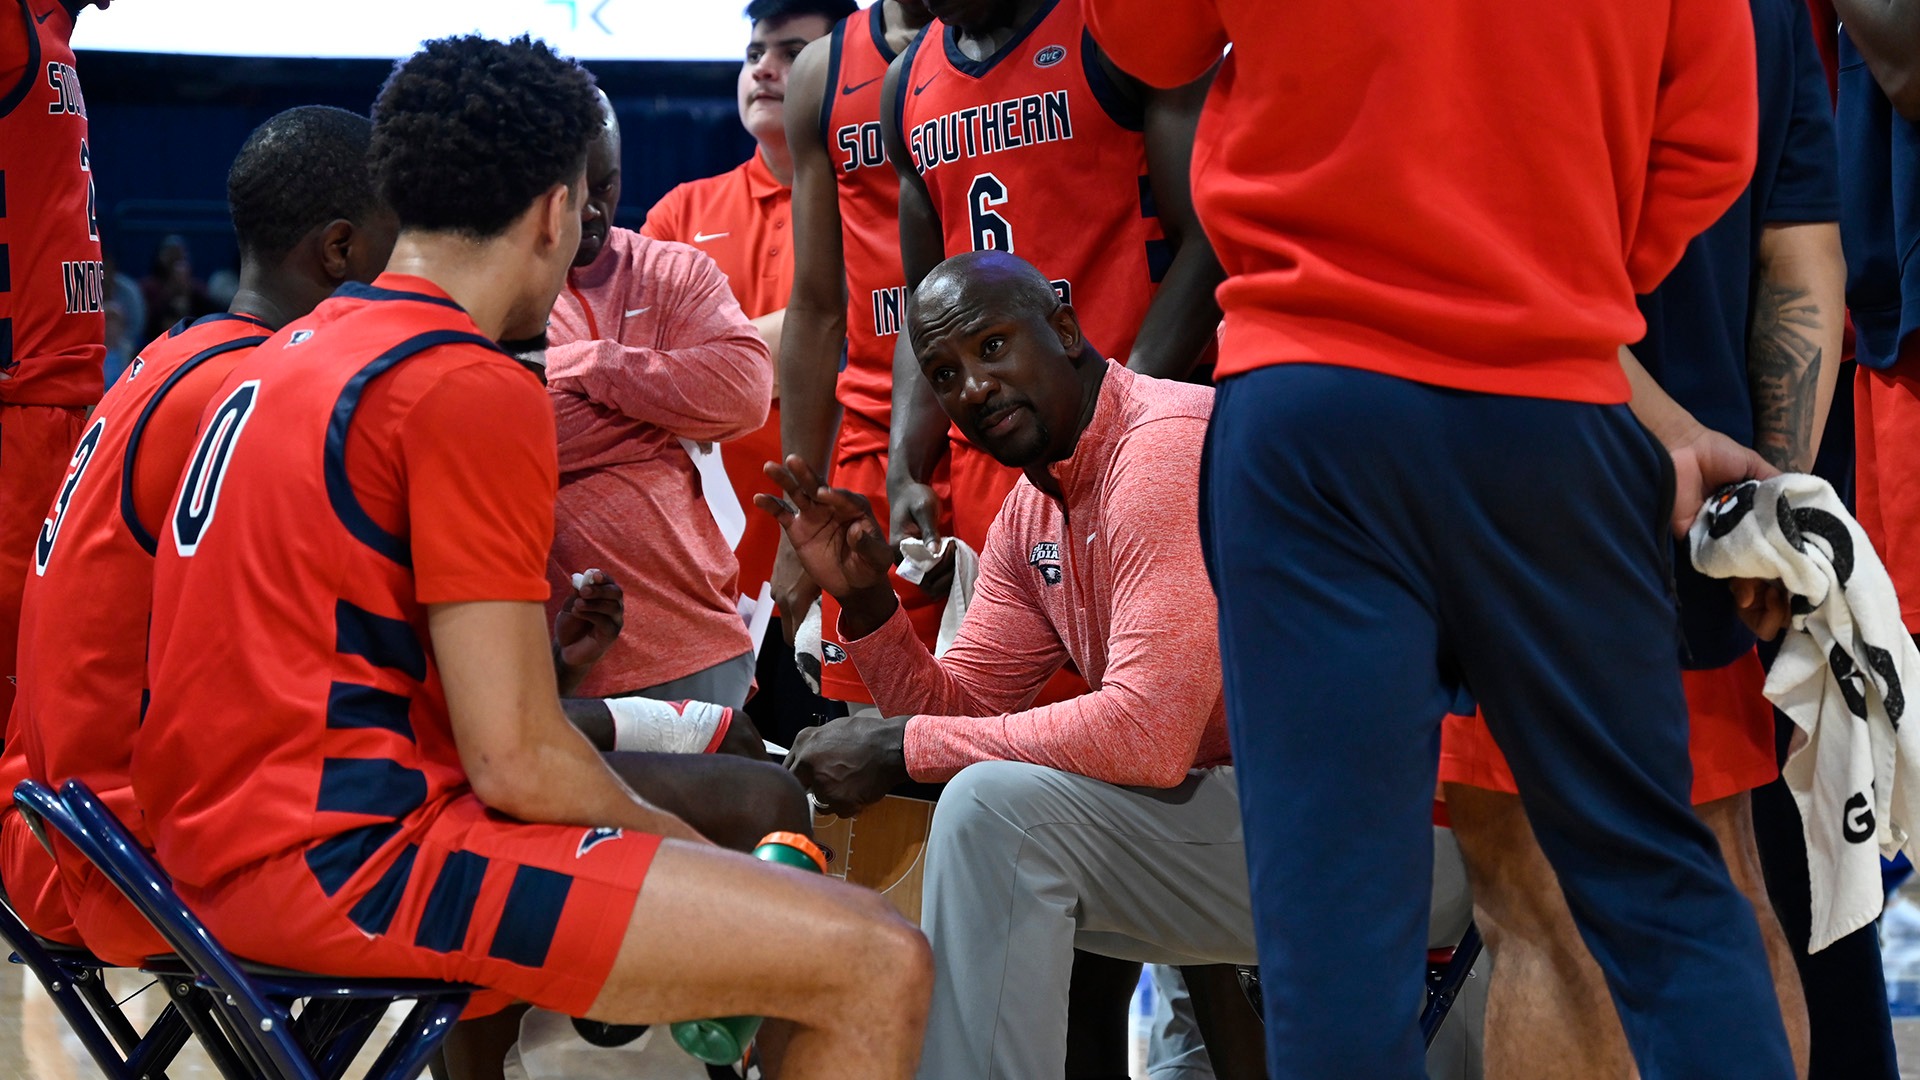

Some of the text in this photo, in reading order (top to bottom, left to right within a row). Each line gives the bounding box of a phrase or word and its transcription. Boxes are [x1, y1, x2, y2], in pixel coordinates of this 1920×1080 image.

[1039, 51, 1059, 62] OVC
[910, 89, 1074, 177] SOUTHERN
[967, 172, 1015, 254] 6
[35, 416, 106, 578] 3
[172, 379, 261, 558] 0
